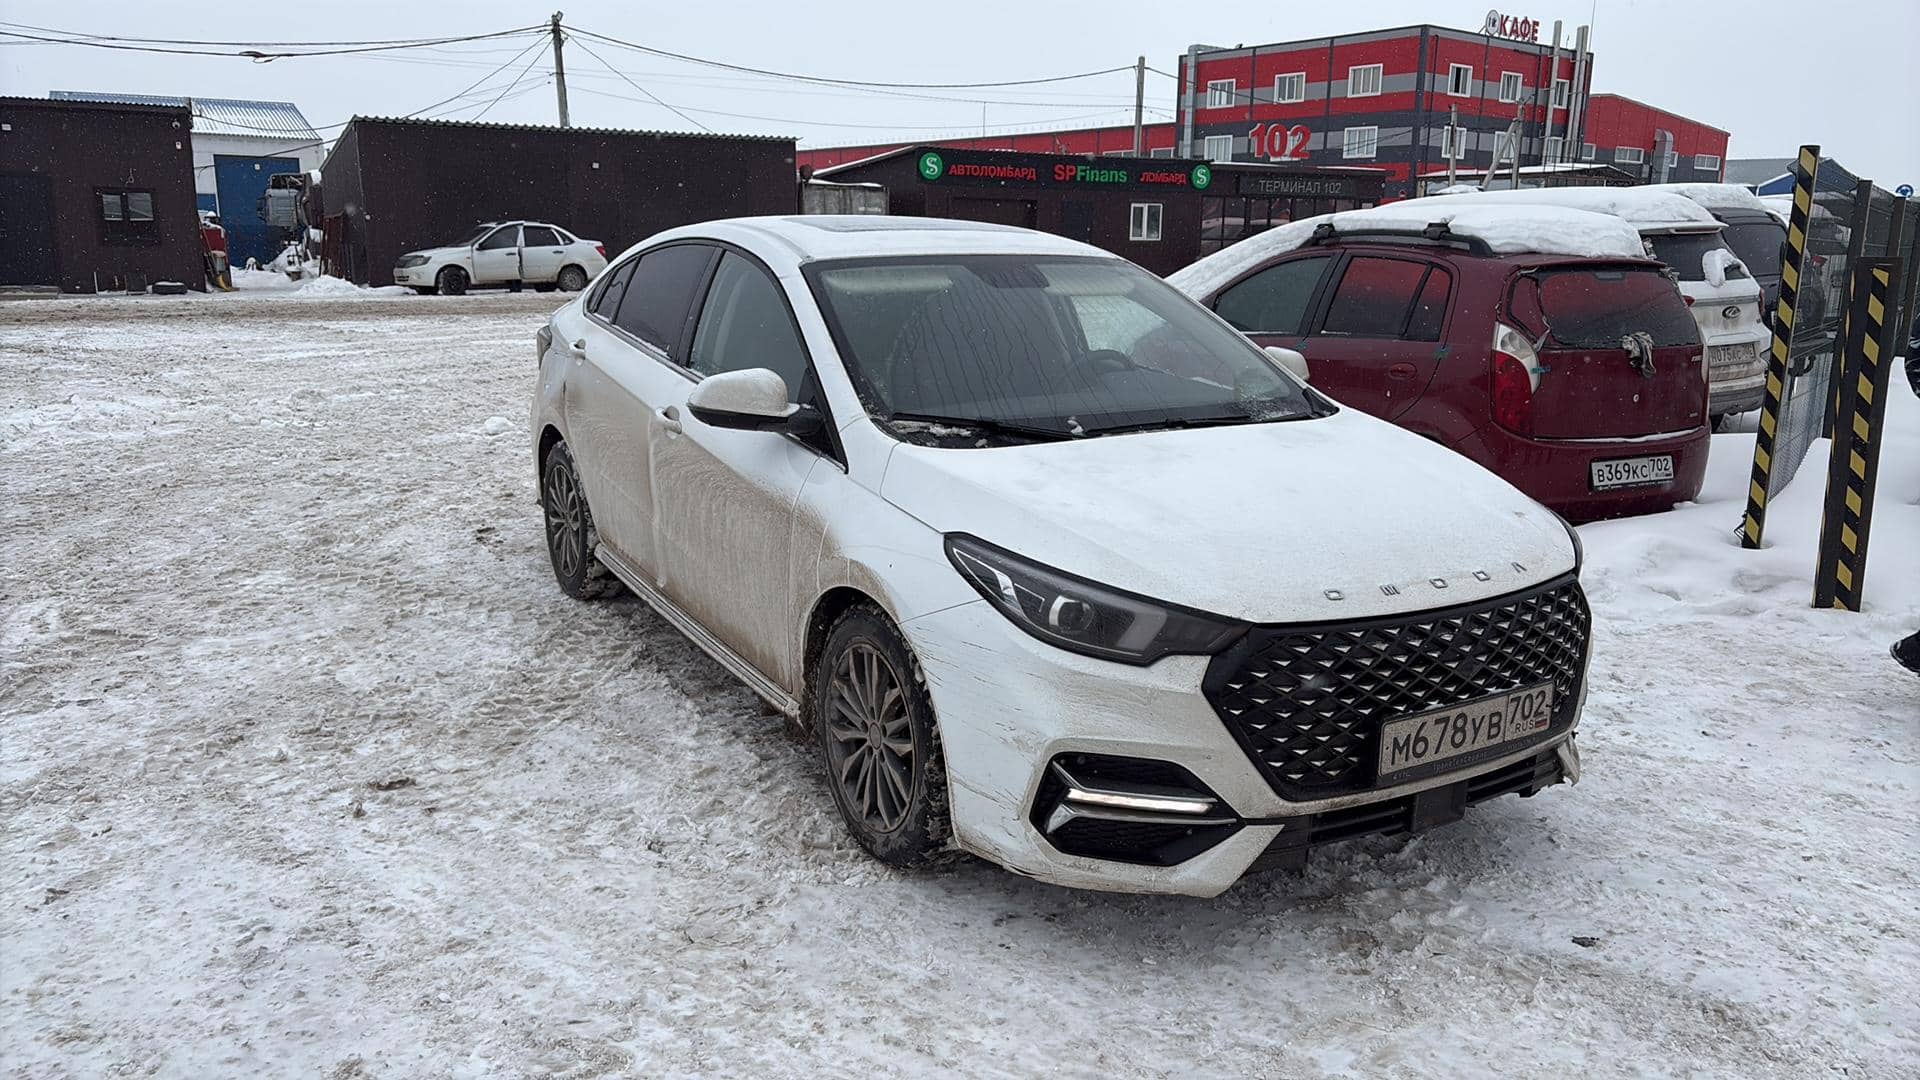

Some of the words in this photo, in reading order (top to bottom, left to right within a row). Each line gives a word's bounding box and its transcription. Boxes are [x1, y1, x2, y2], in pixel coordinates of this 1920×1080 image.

[1500, 14, 1540, 41] КАФЕ
[1249, 122, 1312, 159] 102
[948, 164, 1037, 180] АВТОЛОМБАРД
[1054, 164, 1128, 183] SPFinans
[1140, 172, 1187, 185] ЛОМБАРД
[1259, 180, 1321, 194] ТЕРМИНАЛ
[1324, 182, 1342, 194] 102
[1597, 462, 1648, 482] В369КС
[1650, 458, 1671, 473] 702
[1391, 711, 1503, 765] М678УВ
[1510, 690, 1546, 724] 702
[1515, 719, 1534, 733] RUS
